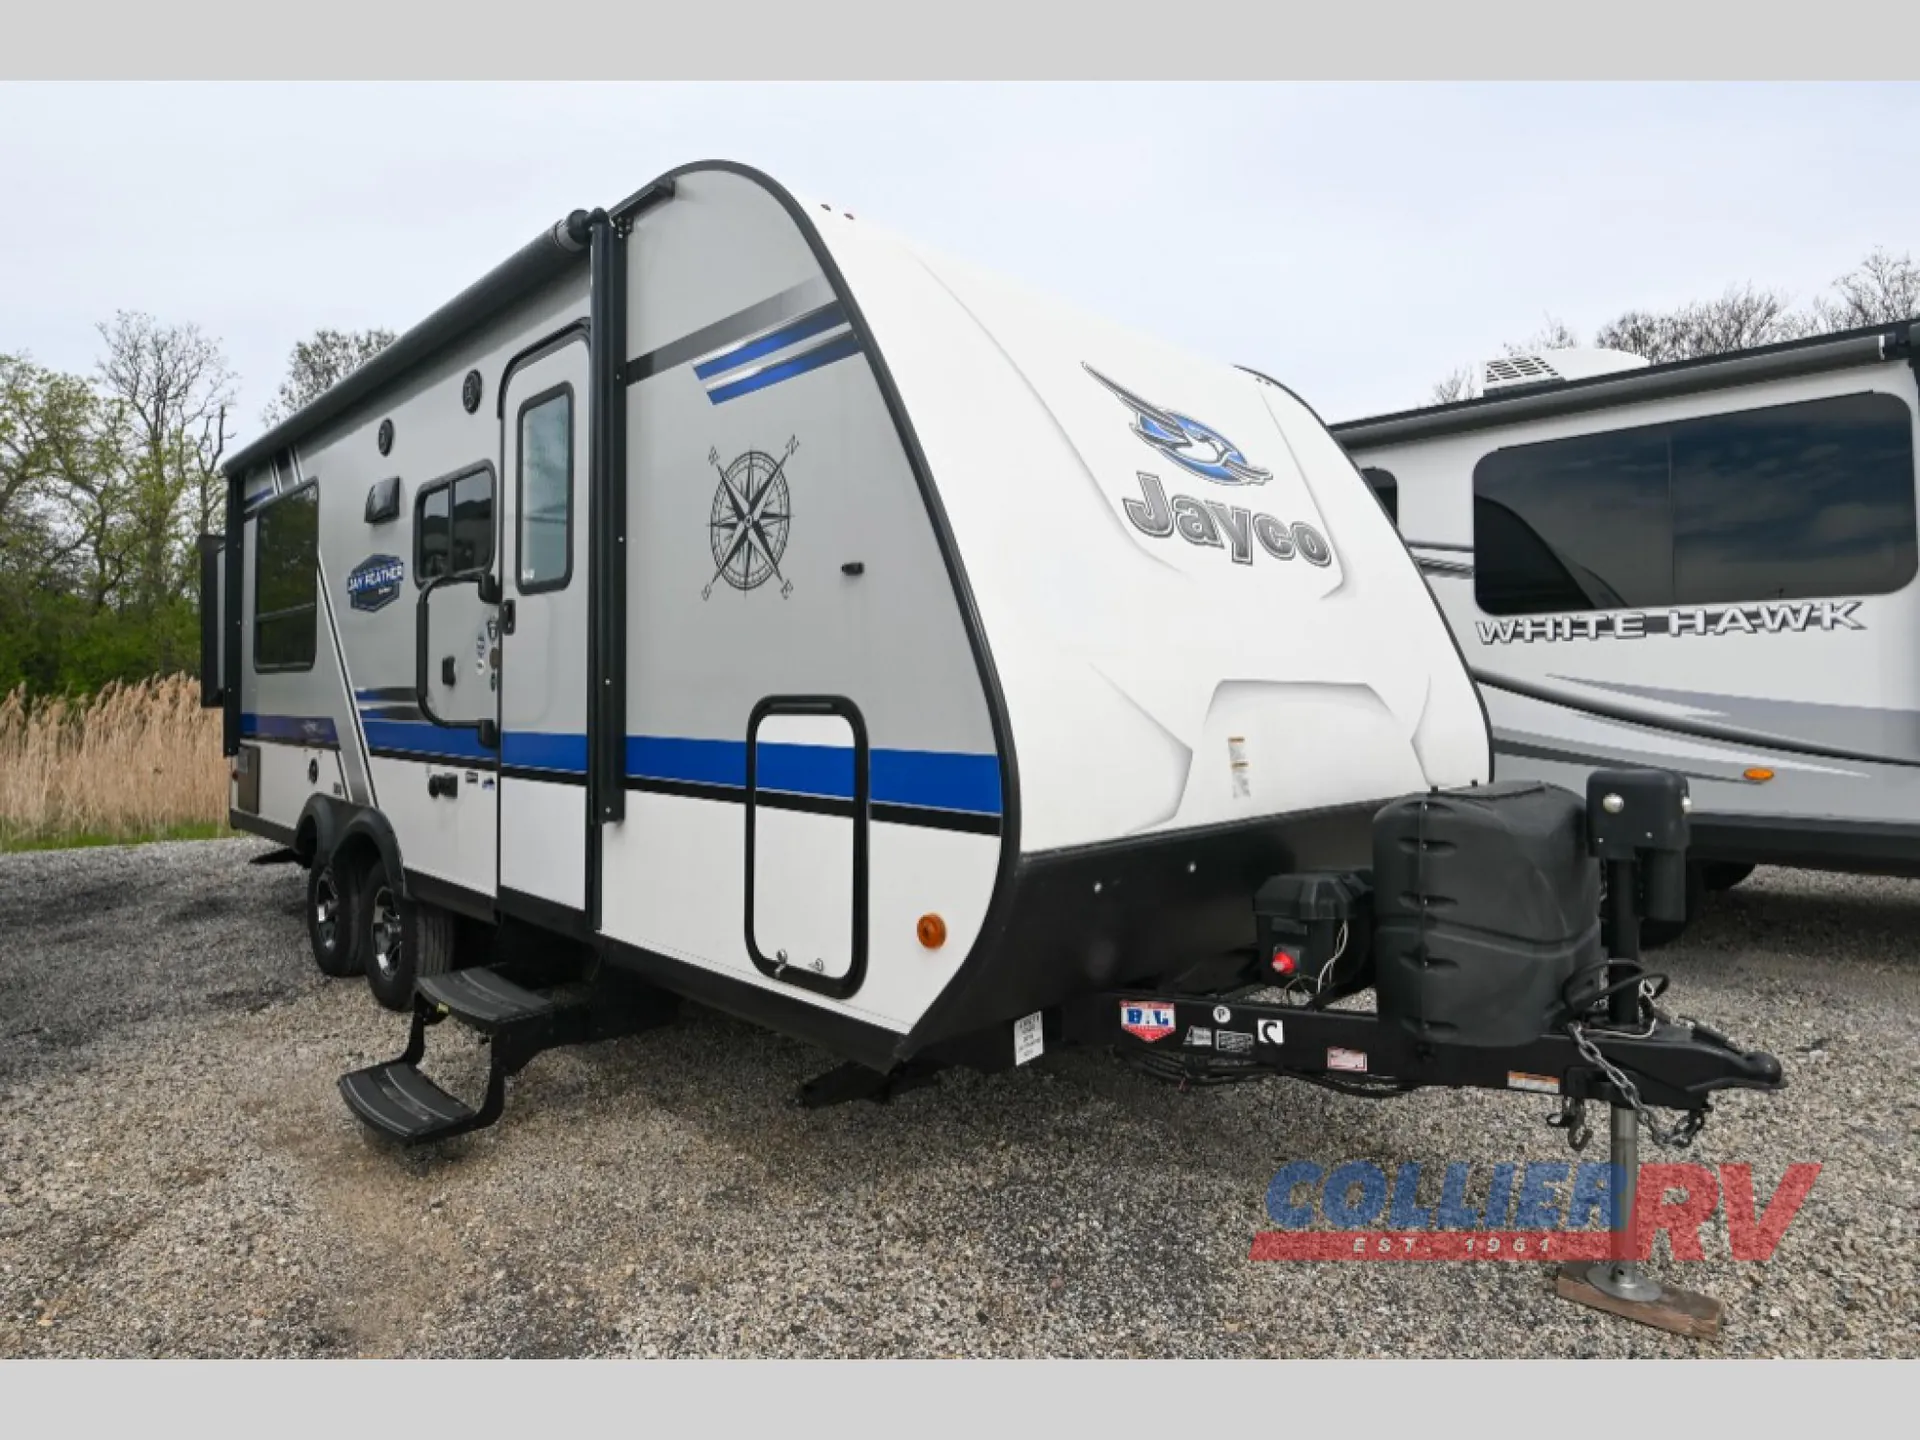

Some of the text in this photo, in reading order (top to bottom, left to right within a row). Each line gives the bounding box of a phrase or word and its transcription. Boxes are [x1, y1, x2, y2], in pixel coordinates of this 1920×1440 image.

[1121, 470, 1332, 568] Jayco
[1475, 600, 1868, 645] WHITE HAWK
